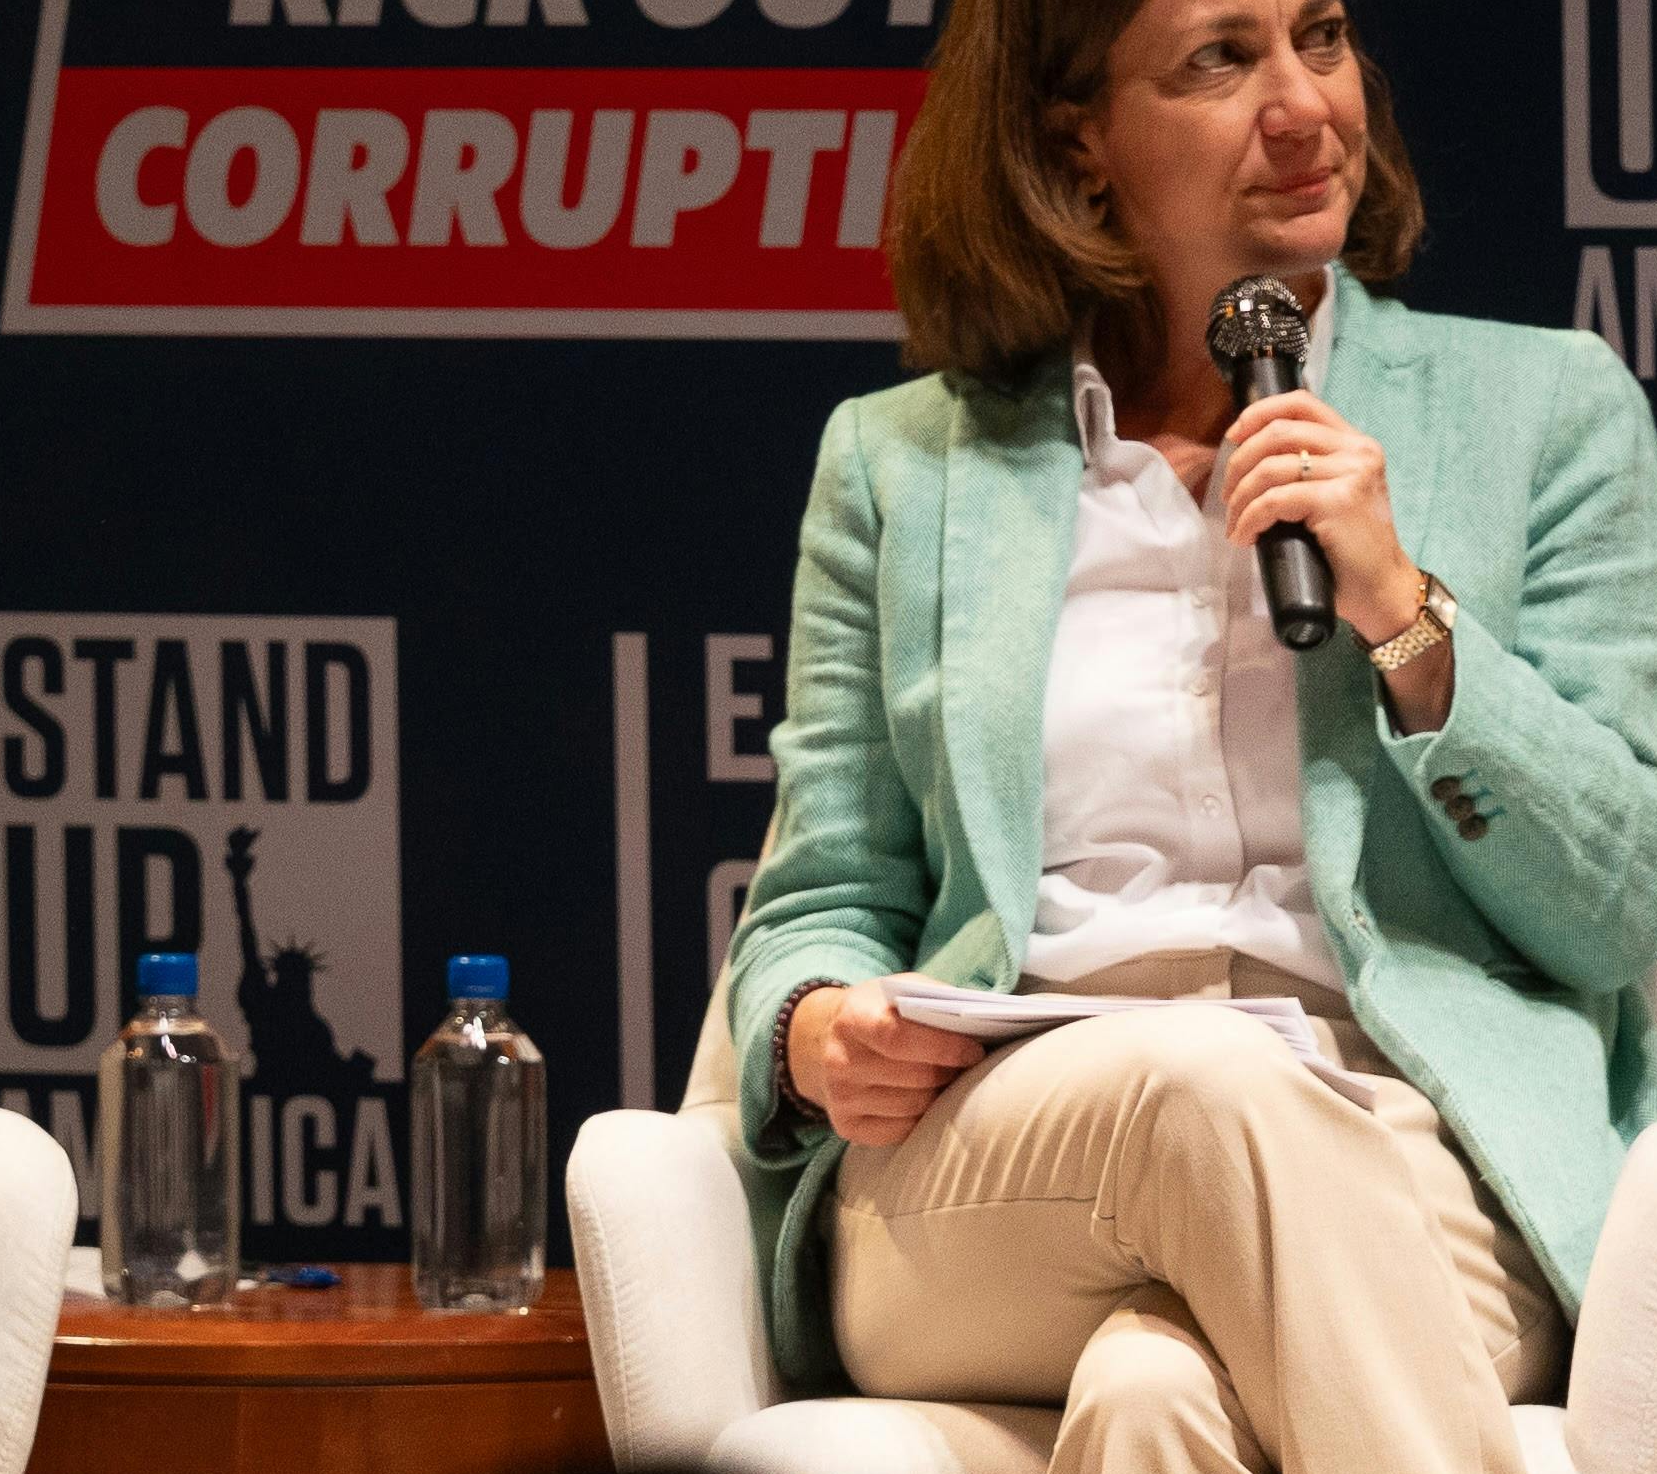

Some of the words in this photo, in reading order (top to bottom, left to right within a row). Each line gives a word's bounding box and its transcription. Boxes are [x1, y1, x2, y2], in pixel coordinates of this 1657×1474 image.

[95, 106, 899, 249] CORRUPTI
[2, 636, 371, 804] STAND
[6, 826, 204, 1046] UP
